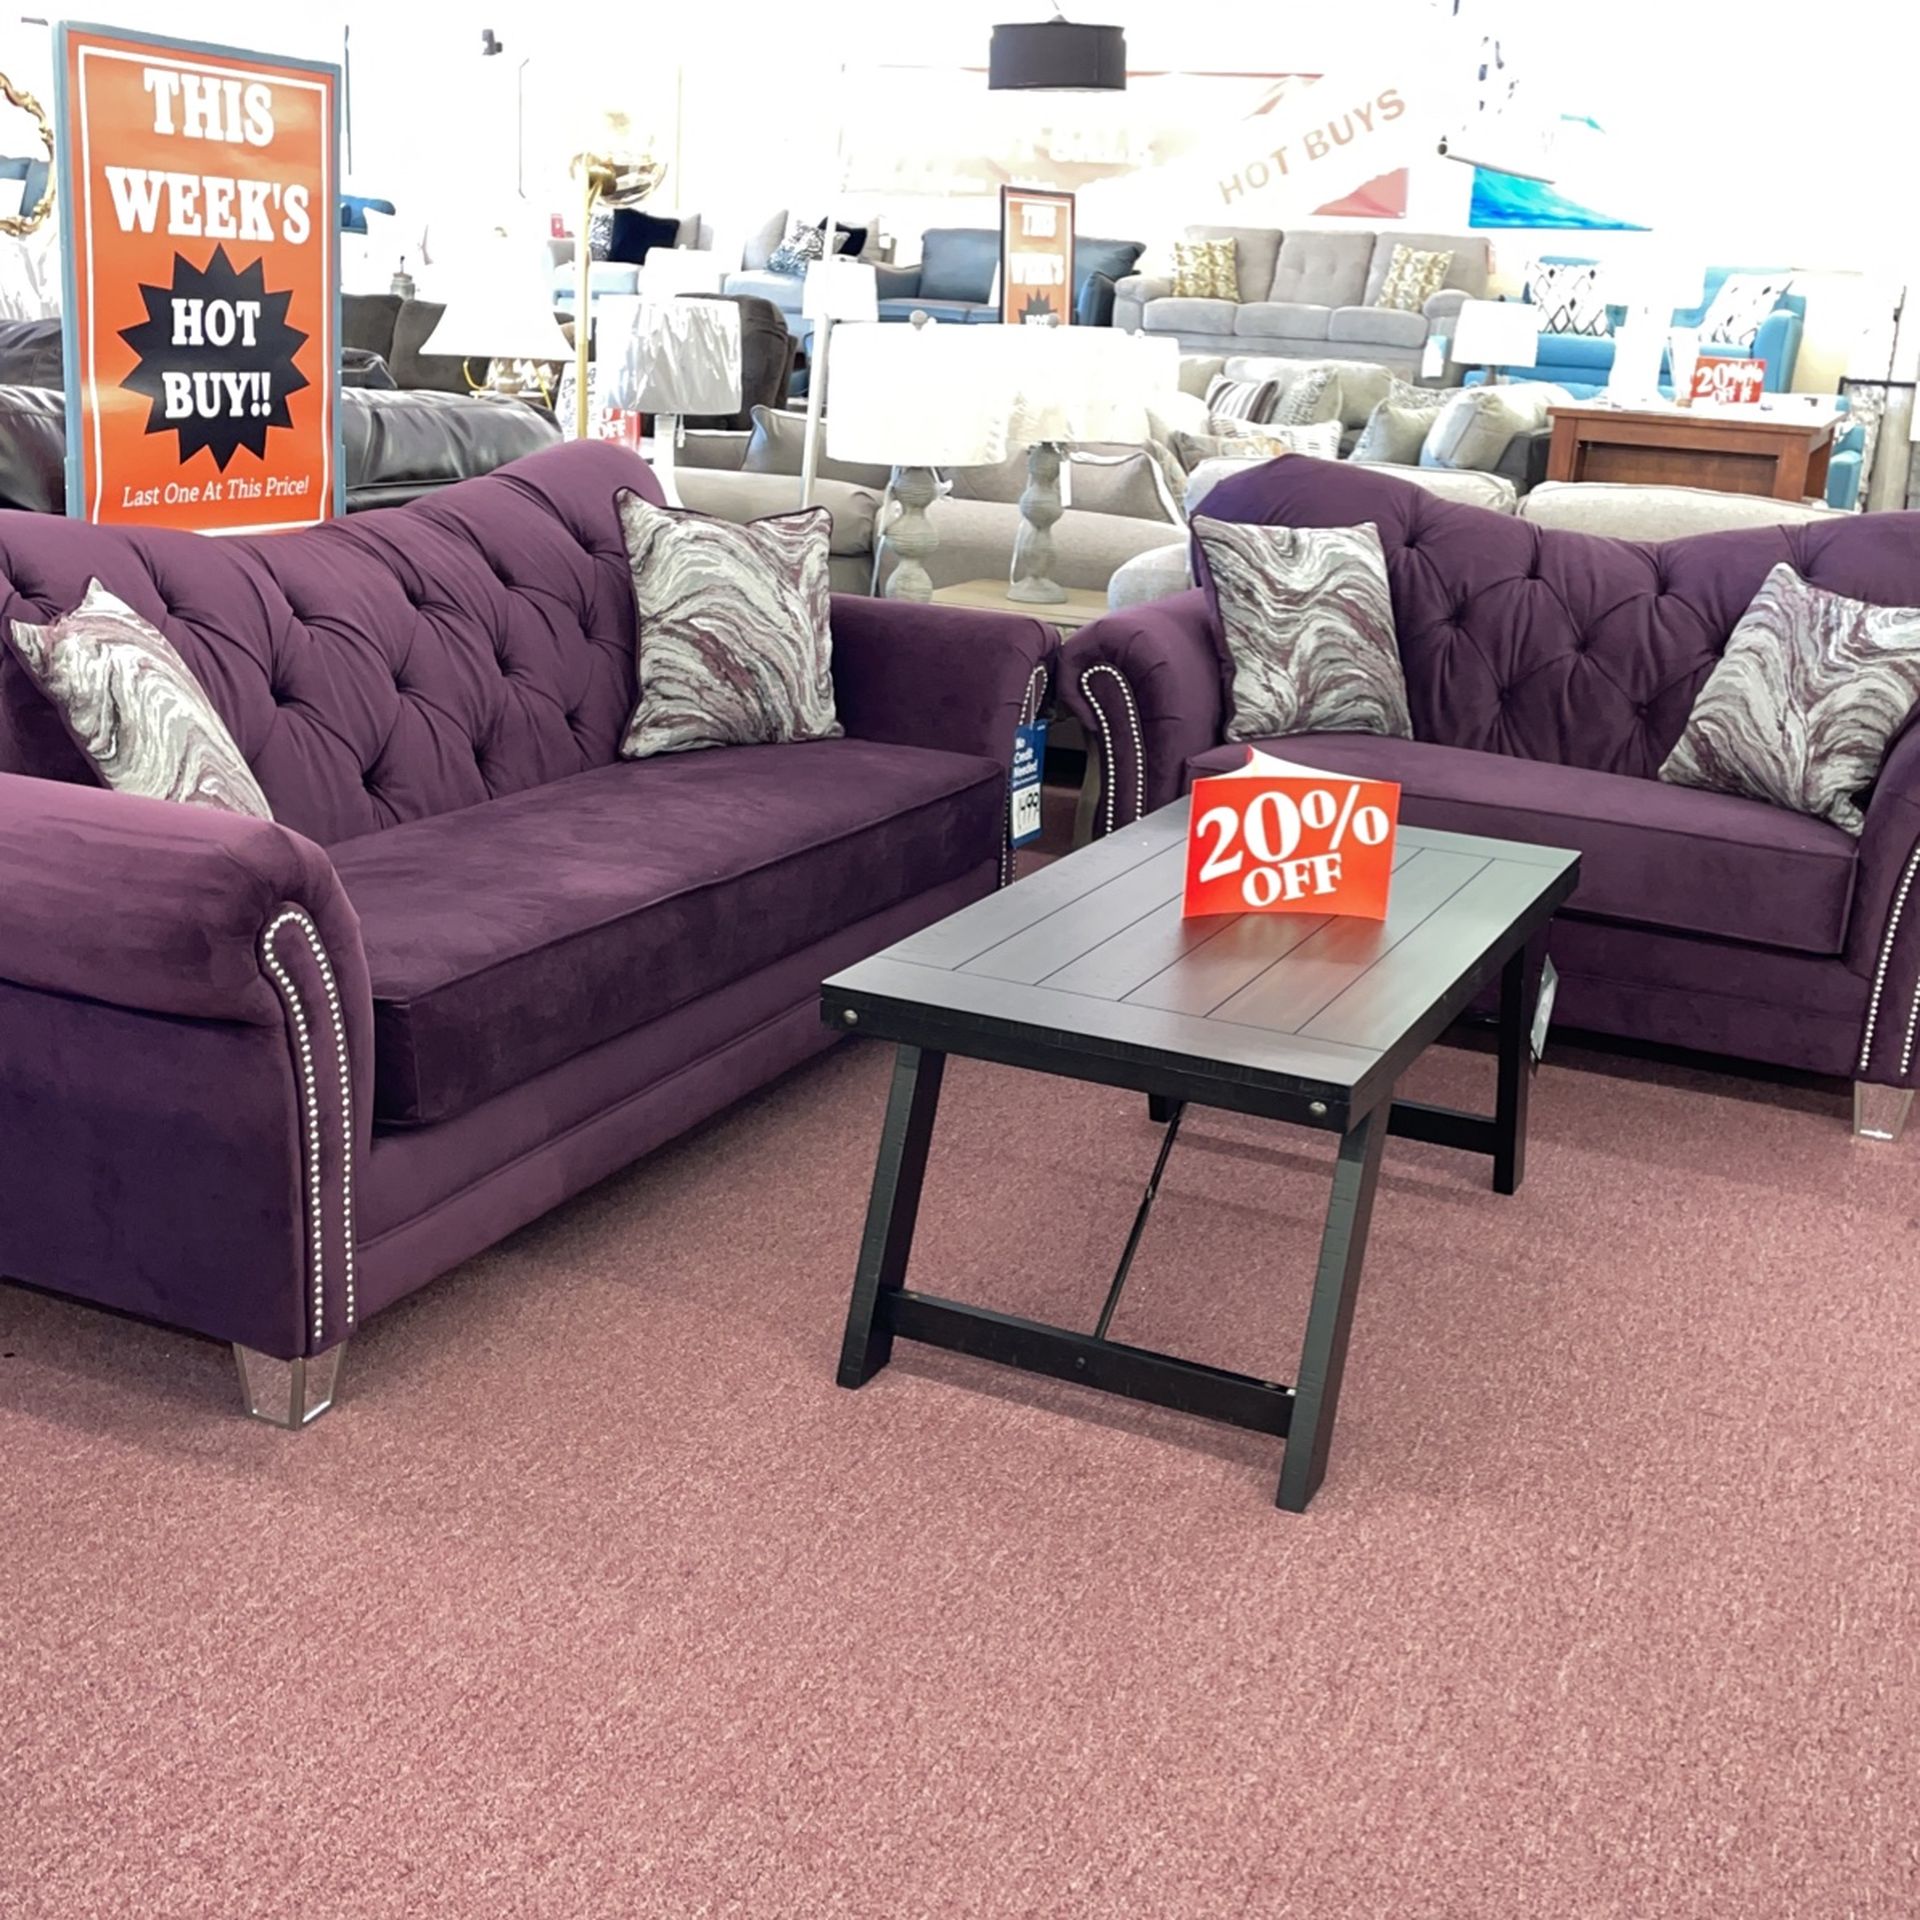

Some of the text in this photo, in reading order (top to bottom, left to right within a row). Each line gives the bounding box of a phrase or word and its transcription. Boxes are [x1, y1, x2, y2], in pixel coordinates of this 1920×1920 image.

[143, 67, 274, 147] THIS
[1218, 88, 1406, 205] HOT BUYS
[104, 165, 311, 244] WEEK'S
[171, 298, 261, 346] HOT
[162, 372, 272, 419] BUY!!
[122, 475, 309, 508] Last One At This Price!
[1196, 784, 1390, 884] 20%
[1242, 852, 1343, 907] OFF
